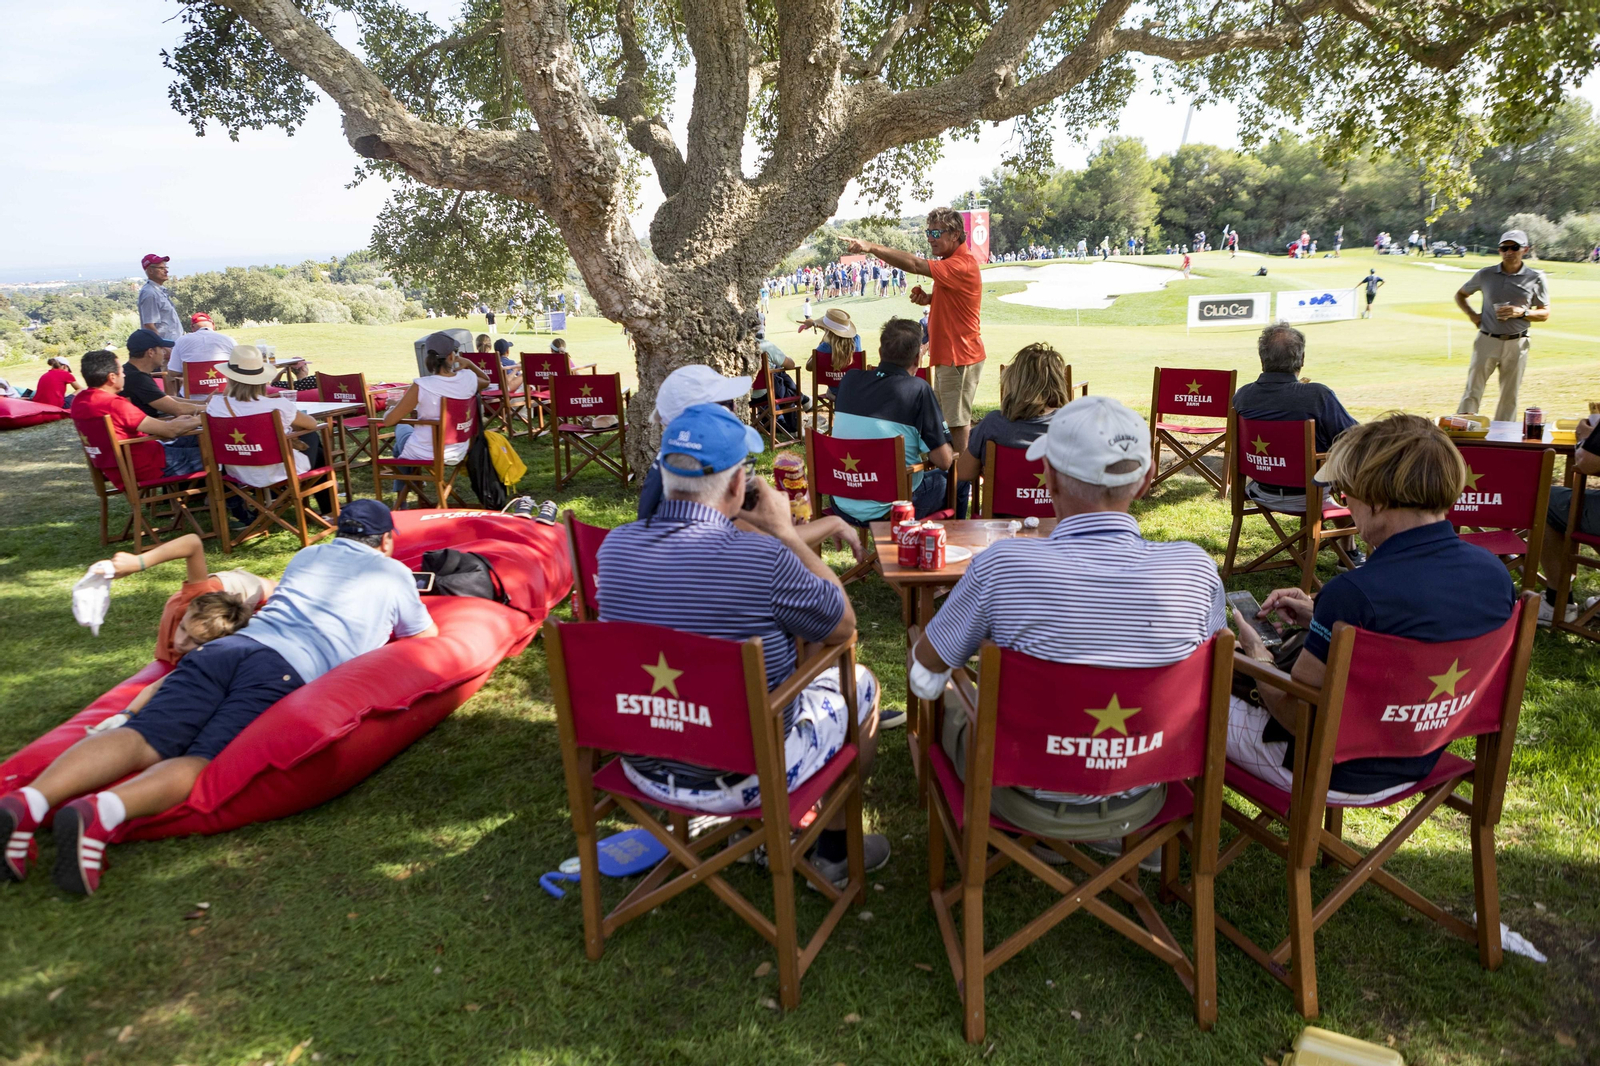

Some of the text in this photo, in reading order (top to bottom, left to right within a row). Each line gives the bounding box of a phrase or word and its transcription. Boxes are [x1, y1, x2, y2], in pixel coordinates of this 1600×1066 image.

[975, 230, 984, 240] 11
[1203, 303, 1249, 316] Club Car
[570, 397, 603, 405] ESTRELLA
[1174, 394, 1212, 403] ESTRELLA
[225, 443, 263, 452] ESTRELLA
[1246, 452, 1287, 467] ESTRELLA
[832, 469, 878, 482] ESTRELLA
[1016, 488, 1052, 499] ESTRE
[1456, 492, 1502, 505] RELLA
[615, 693, 713, 728] ESTRELLA
[1380, 689, 1476, 722] ESTRELLA
[650, 716, 685, 733] DAMM
[1413, 717, 1449, 733] DAMM
[1046, 730, 1164, 758] ESTRELLA
[1085, 757, 1128, 770] DAMM
